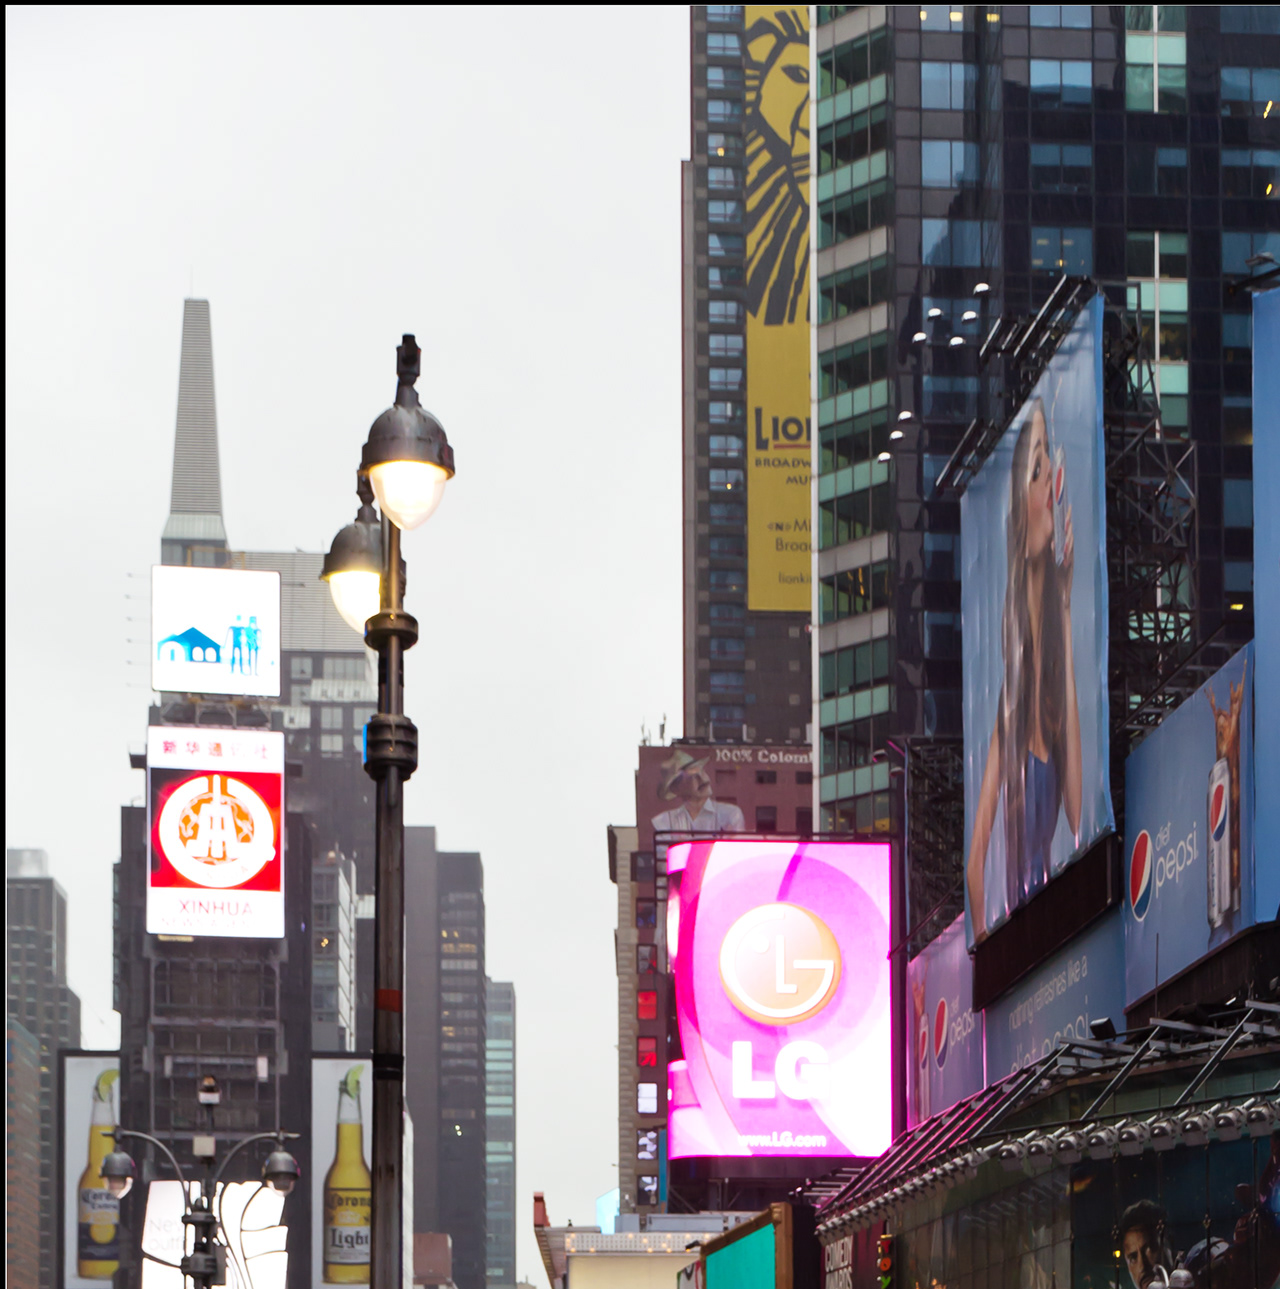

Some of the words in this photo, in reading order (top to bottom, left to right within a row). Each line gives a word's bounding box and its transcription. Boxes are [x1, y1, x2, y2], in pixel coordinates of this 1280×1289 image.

[1155, 821, 1199, 899] pepsi
[180, 899, 253, 916] XINHUA
[732, 1040, 832, 1100] LG
